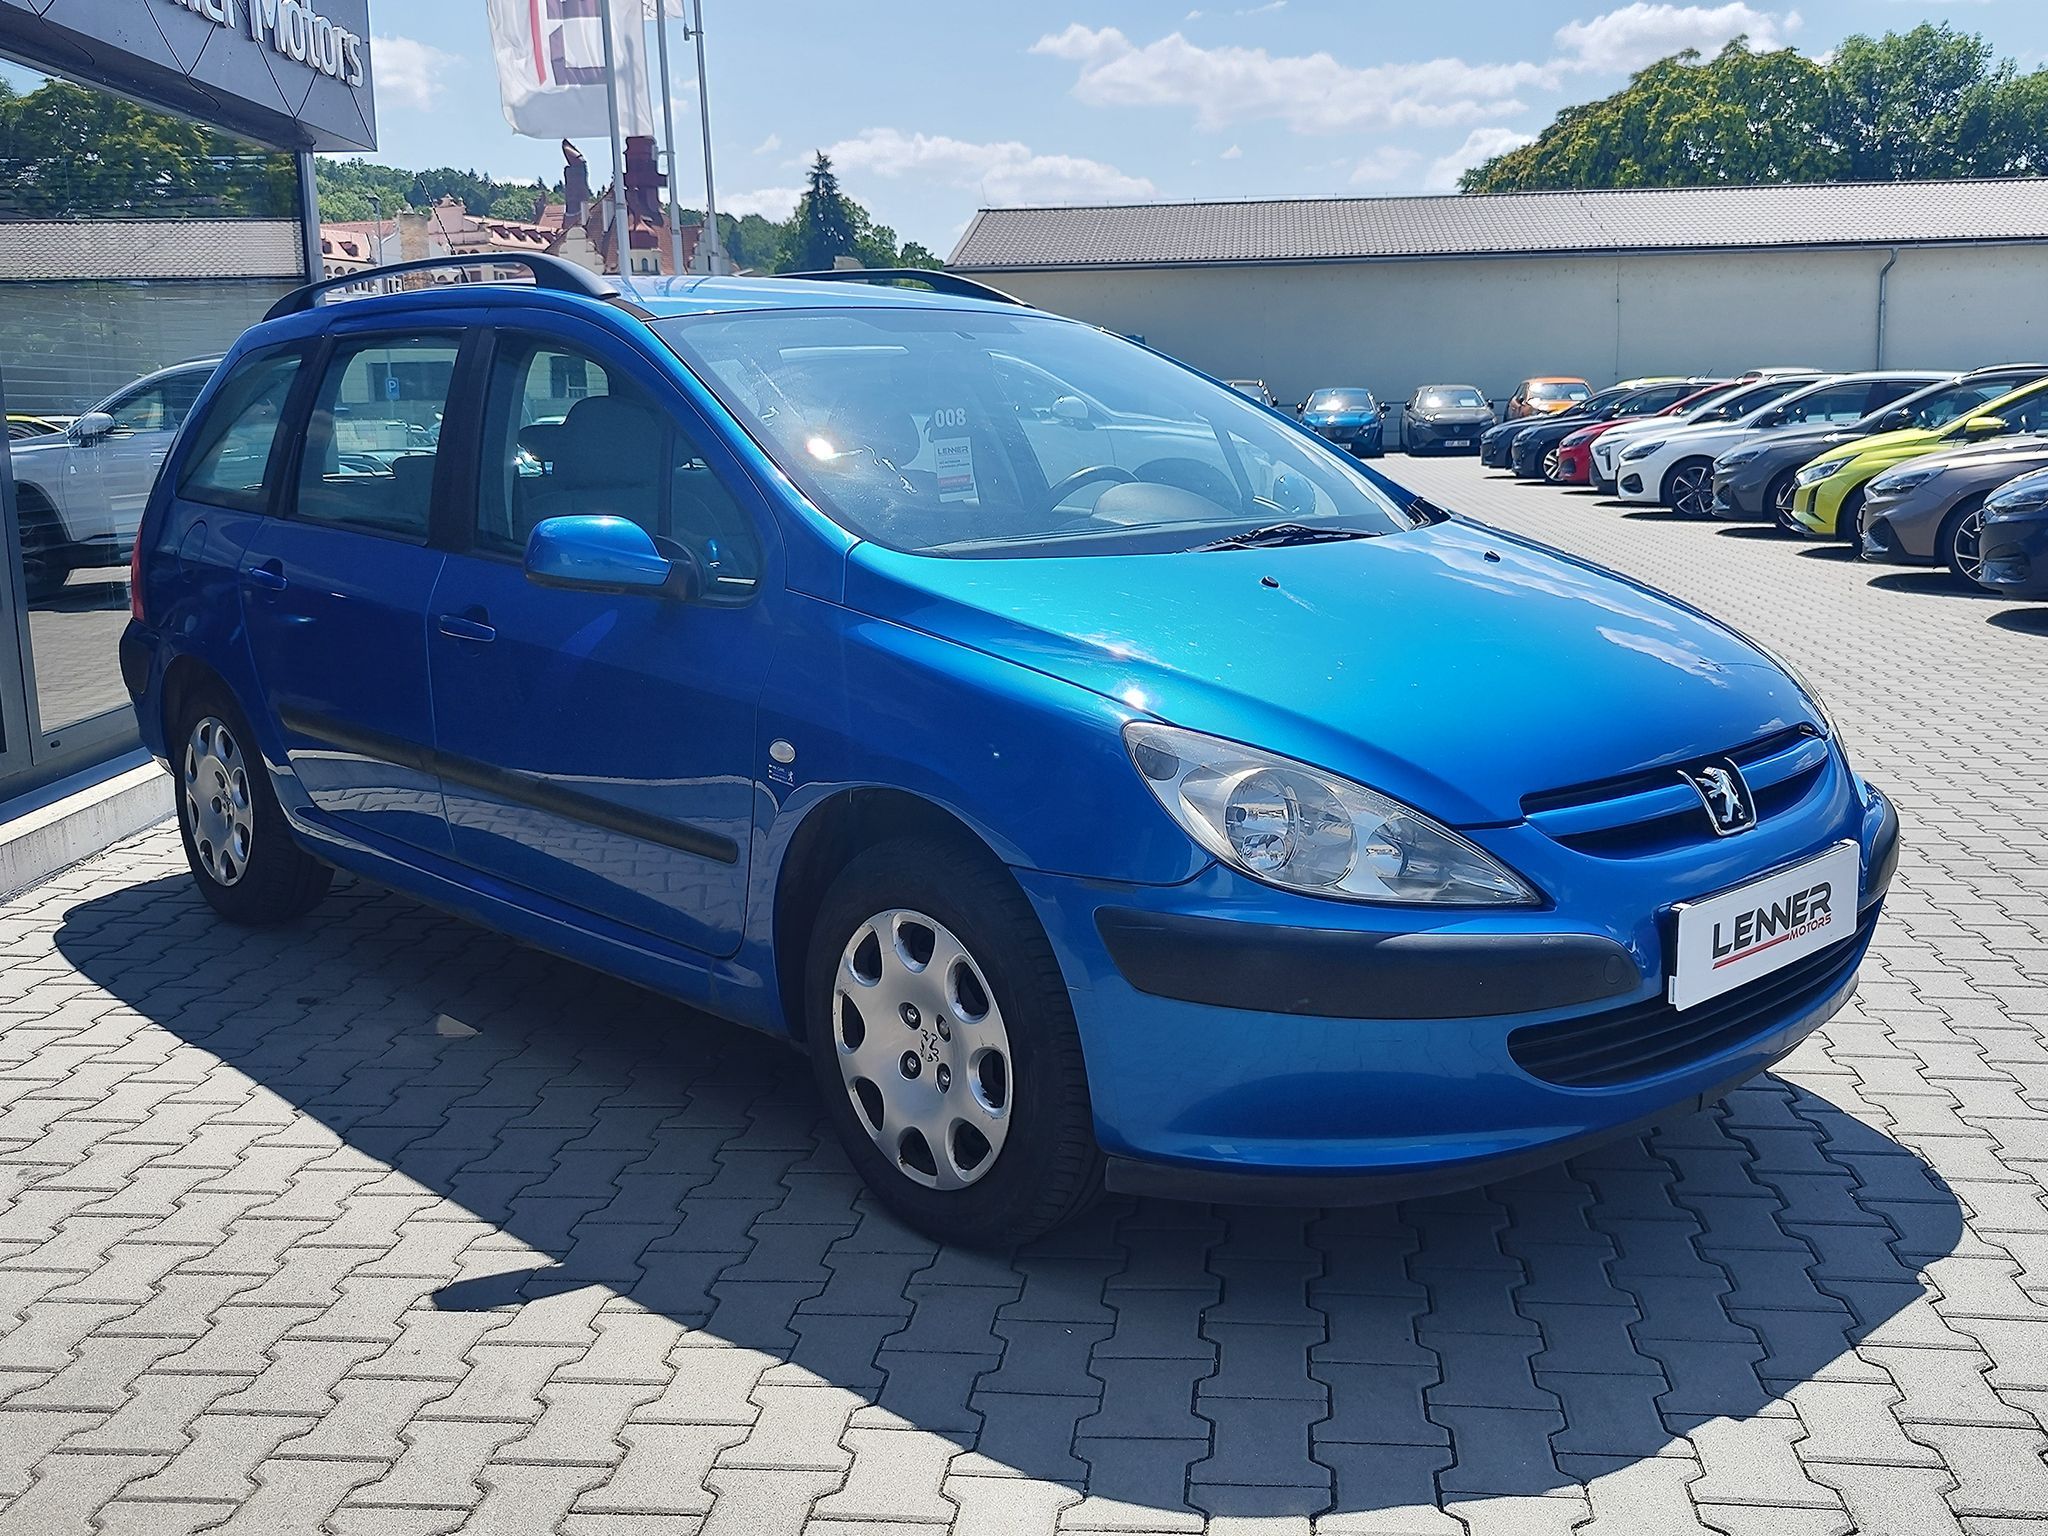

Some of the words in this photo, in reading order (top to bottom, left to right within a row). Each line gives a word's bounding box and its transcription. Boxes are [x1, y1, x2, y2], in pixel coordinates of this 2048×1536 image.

[935, 407, 967, 428] 008
[1712, 881, 1832, 960] LENNER
[1788, 913, 1832, 941] MOTORS
